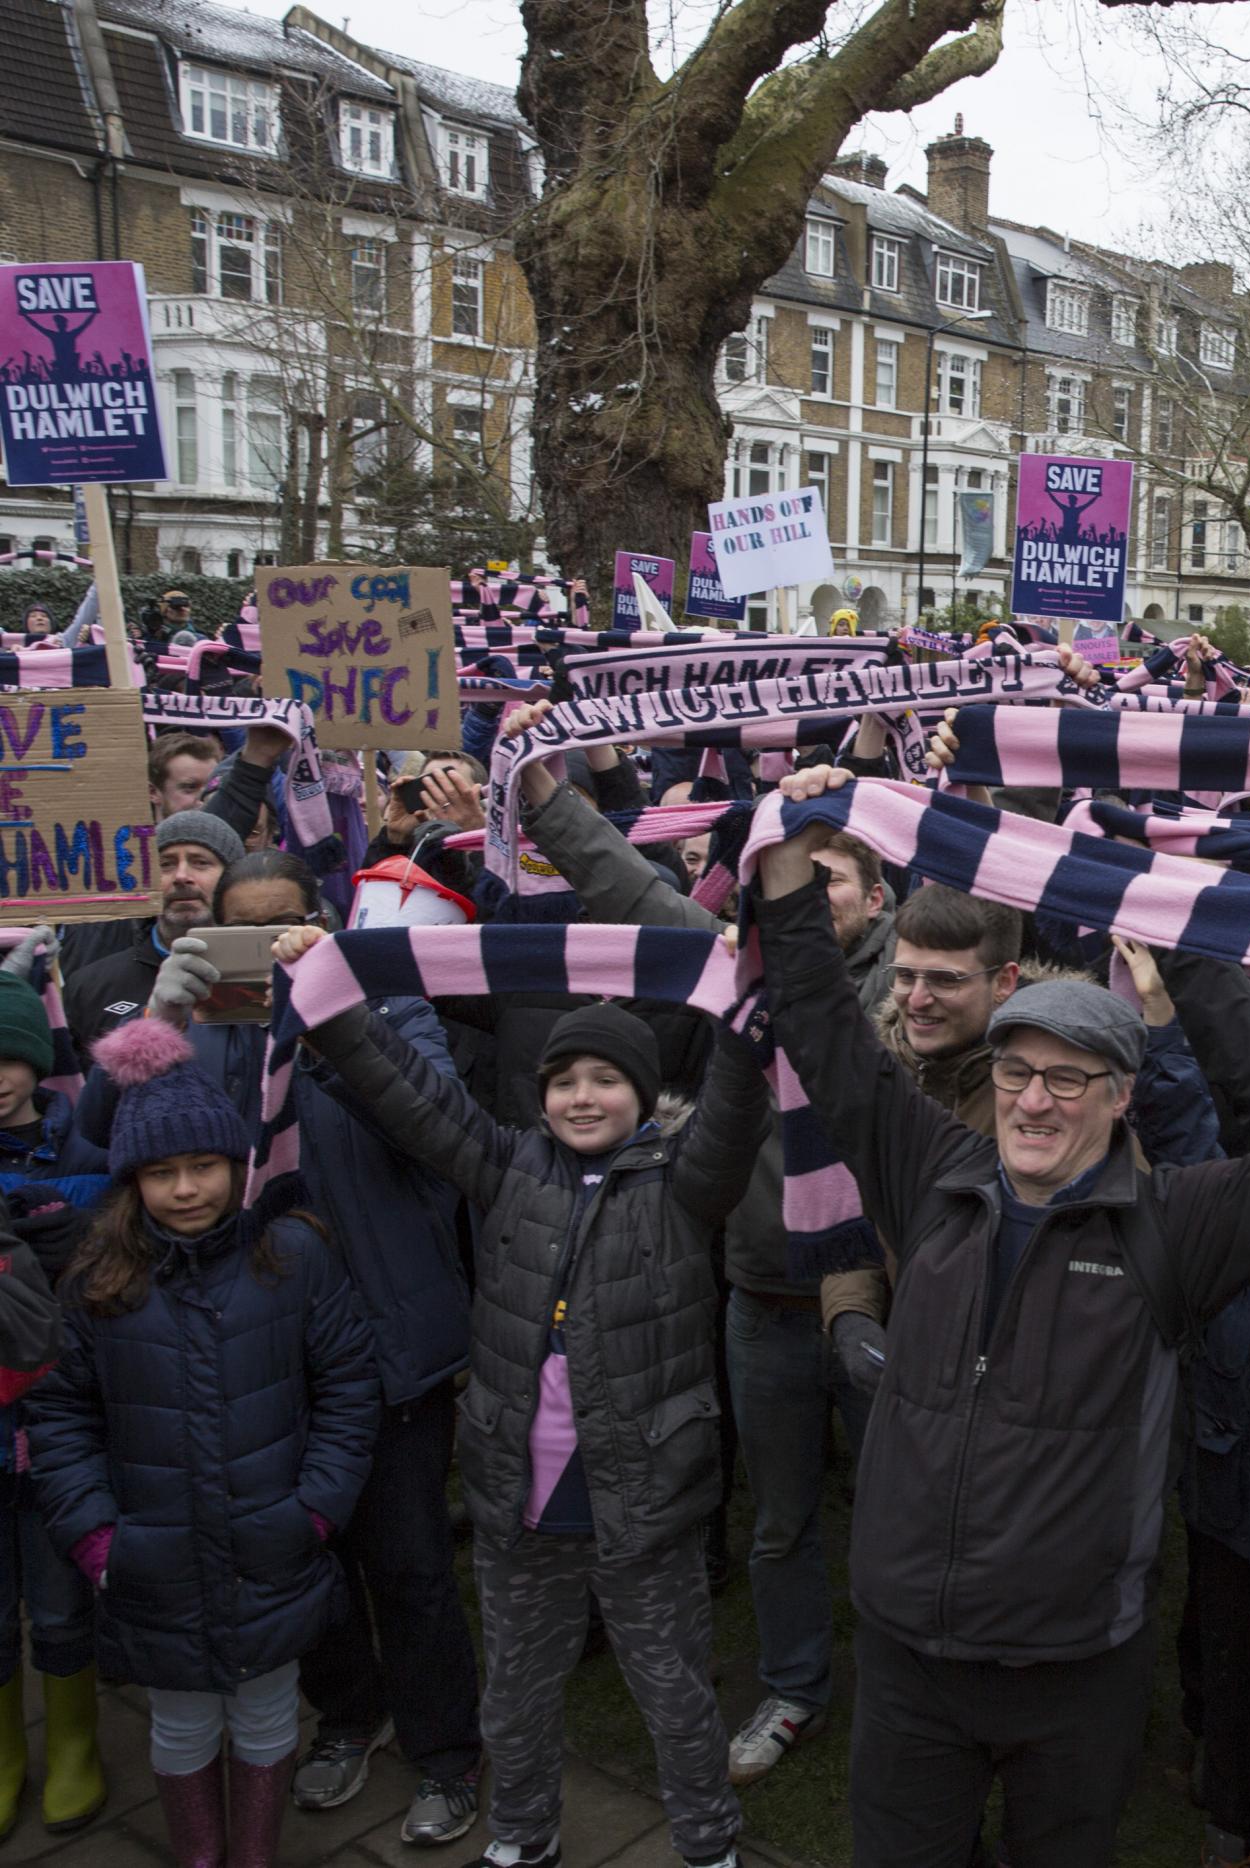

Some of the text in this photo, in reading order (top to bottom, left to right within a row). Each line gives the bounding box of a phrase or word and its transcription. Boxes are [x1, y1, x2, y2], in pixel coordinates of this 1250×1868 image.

[17, 277, 97, 311] SAVE
[6, 381, 147, 411] DULWICH
[9, 407, 148, 440] HAMLET
[1047, 465, 1101, 493] SAVE
[713, 495, 813, 531] HANDS OFF
[724, 532, 765, 555] OUR
[771, 522, 812, 546] HILL
[1022, 540, 1121, 567] DULWICH
[631, 559, 659, 575] SAVE
[1020, 560, 1119, 588] HAMLET
[572, 665, 670, 701] WICH
[777, 653, 1031, 712] HAMLET
[0, 819, 156, 897] HAMLET
